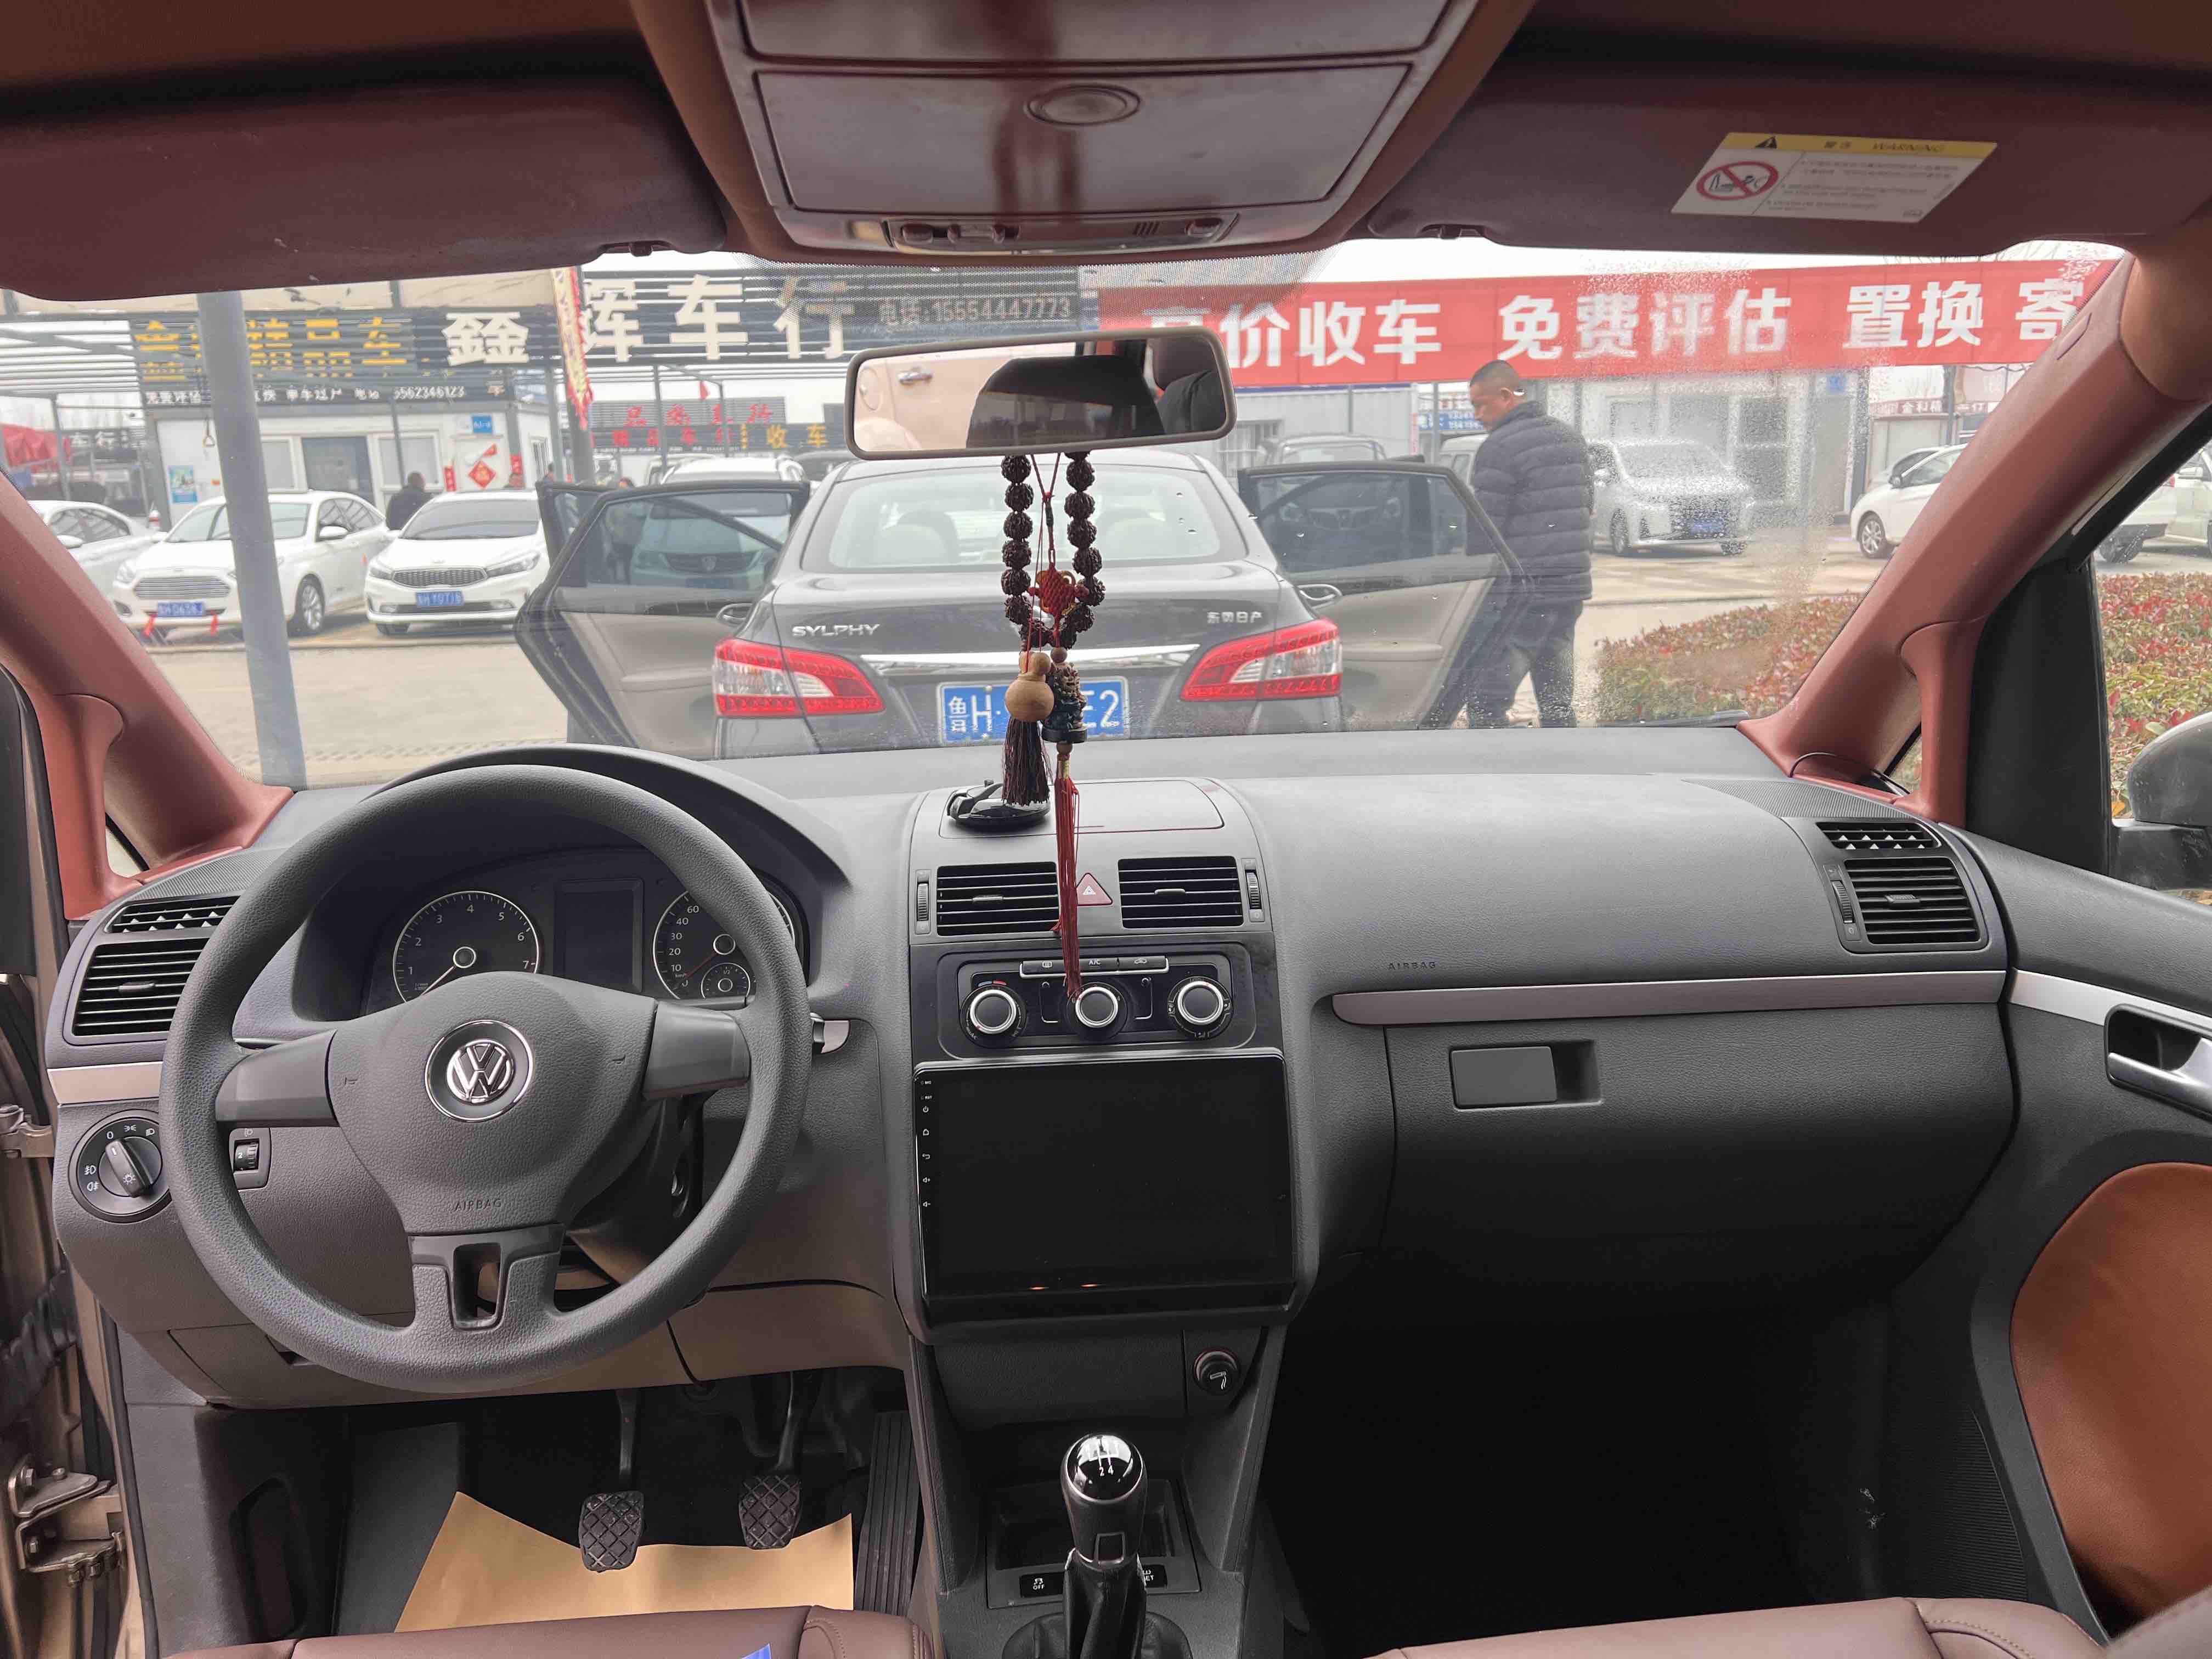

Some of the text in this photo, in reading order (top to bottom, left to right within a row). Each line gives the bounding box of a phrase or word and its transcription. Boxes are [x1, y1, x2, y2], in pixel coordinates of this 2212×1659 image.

[1498, 287, 1791, 361] 免费评估
[1843, 280, 1983, 348] 置换
[792, 624, 881, 636] SYLPHY
[467, 905, 475, 913] 4
[687, 905, 699, 913] 60
[498, 912, 505, 921] 5
[518, 932, 524, 941] 6
[415, 938, 422, 946] 2
[669, 947, 681, 956] 20
[523, 961, 529, 969] 7
[1387, 961, 1436, 970] AIRBAG
[455, 1198, 501, 1211] AIRBAG
[1099, 1465, 1114, 1477] 2 4
